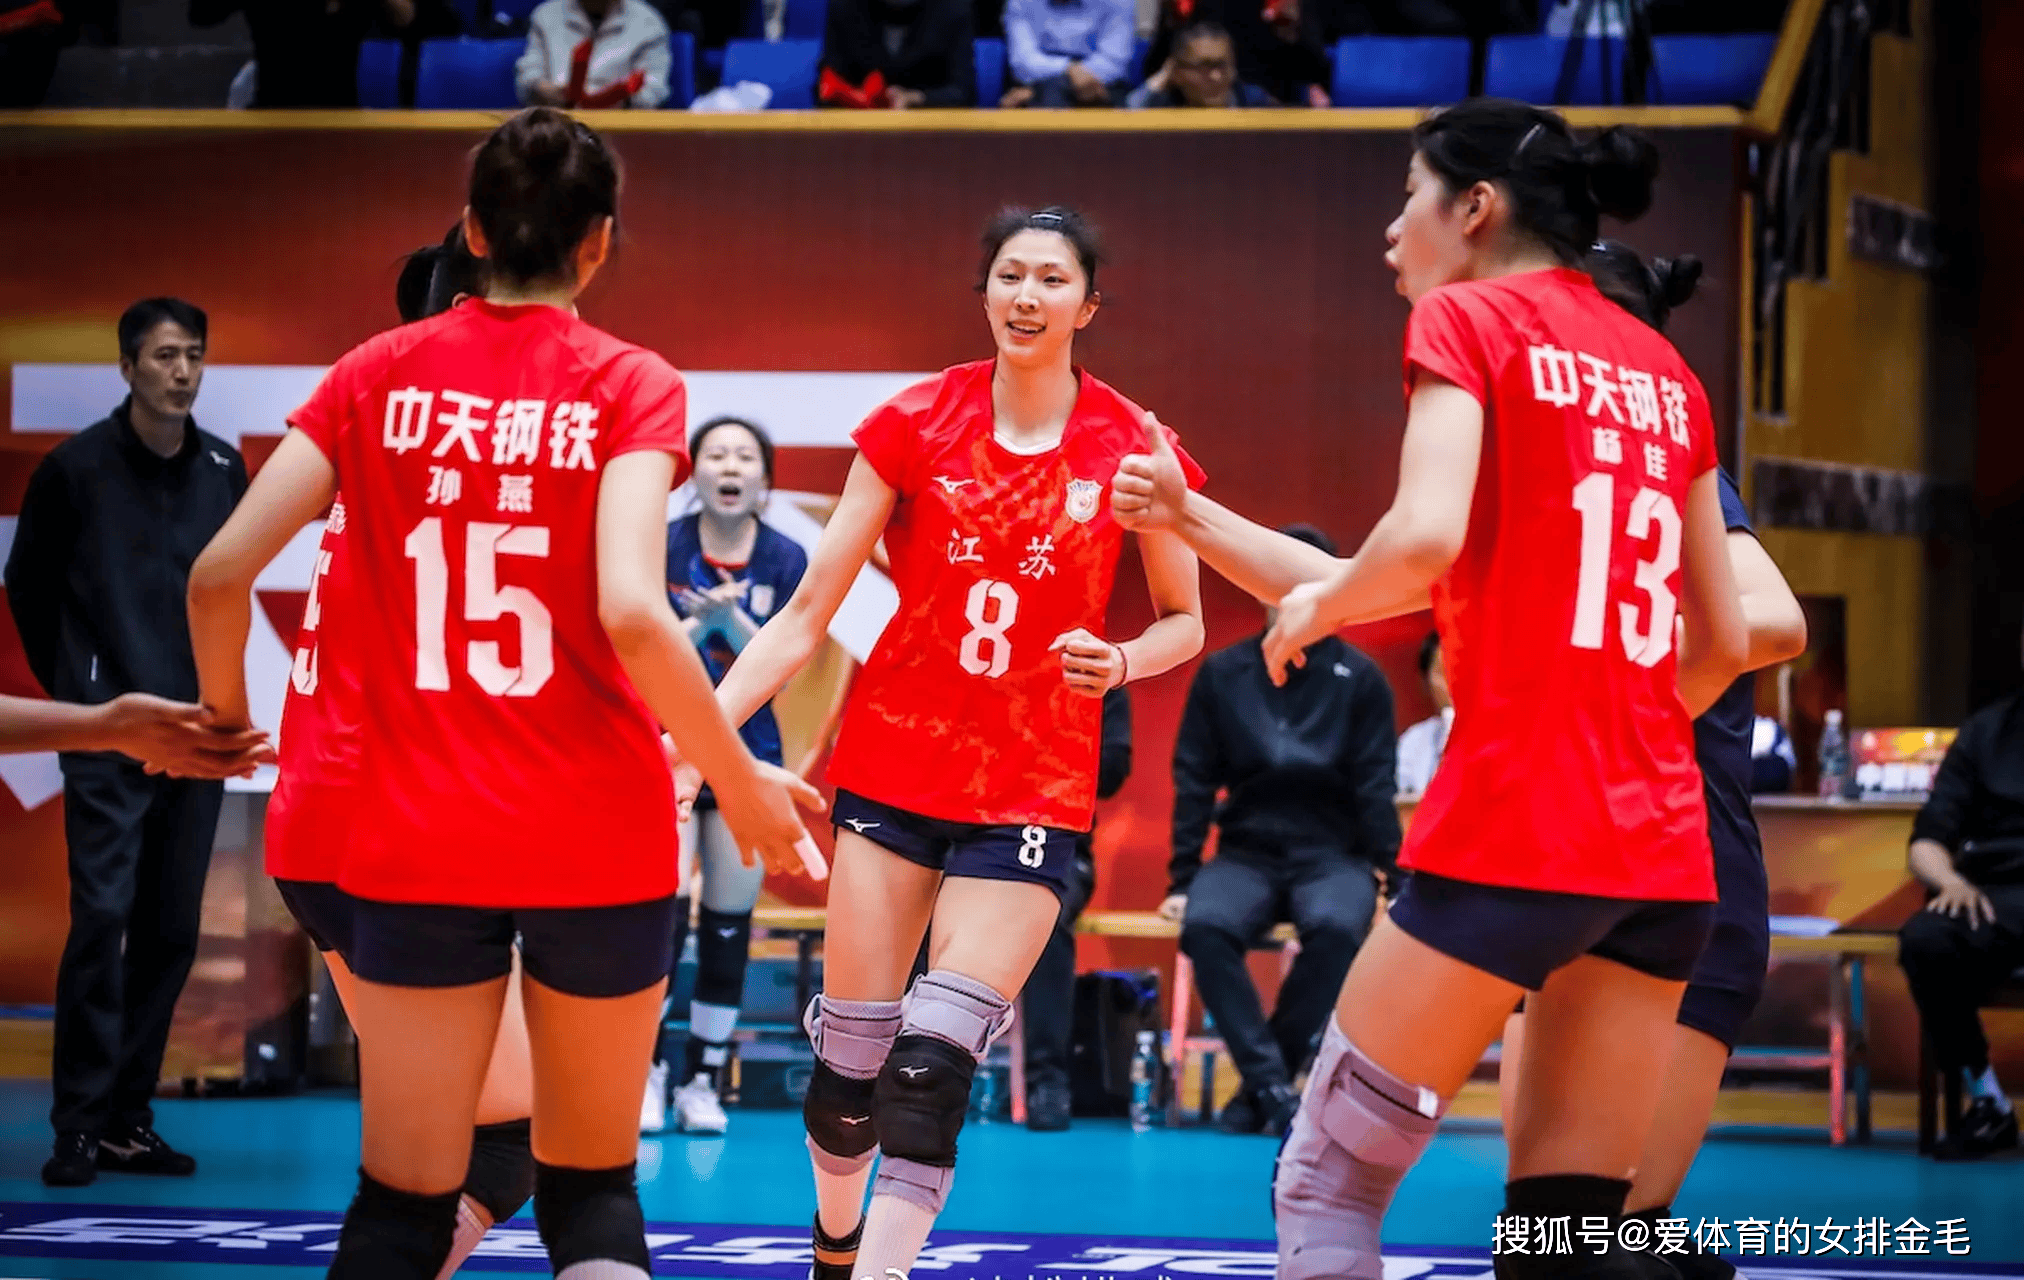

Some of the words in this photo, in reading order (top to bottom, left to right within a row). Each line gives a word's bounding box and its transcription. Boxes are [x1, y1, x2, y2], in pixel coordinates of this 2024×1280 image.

[382, 385, 600, 472] 中天钢铁
[1528, 343, 1692, 451] 中天钢铁
[425, 464, 535, 513] 孙燕
[946, 527, 1057, 581] 江苏
[1569, 471, 1683, 668] 13
[404, 516, 554, 697] 15
[958, 577, 1021, 680] 8
[1018, 824, 1048, 869] 8
